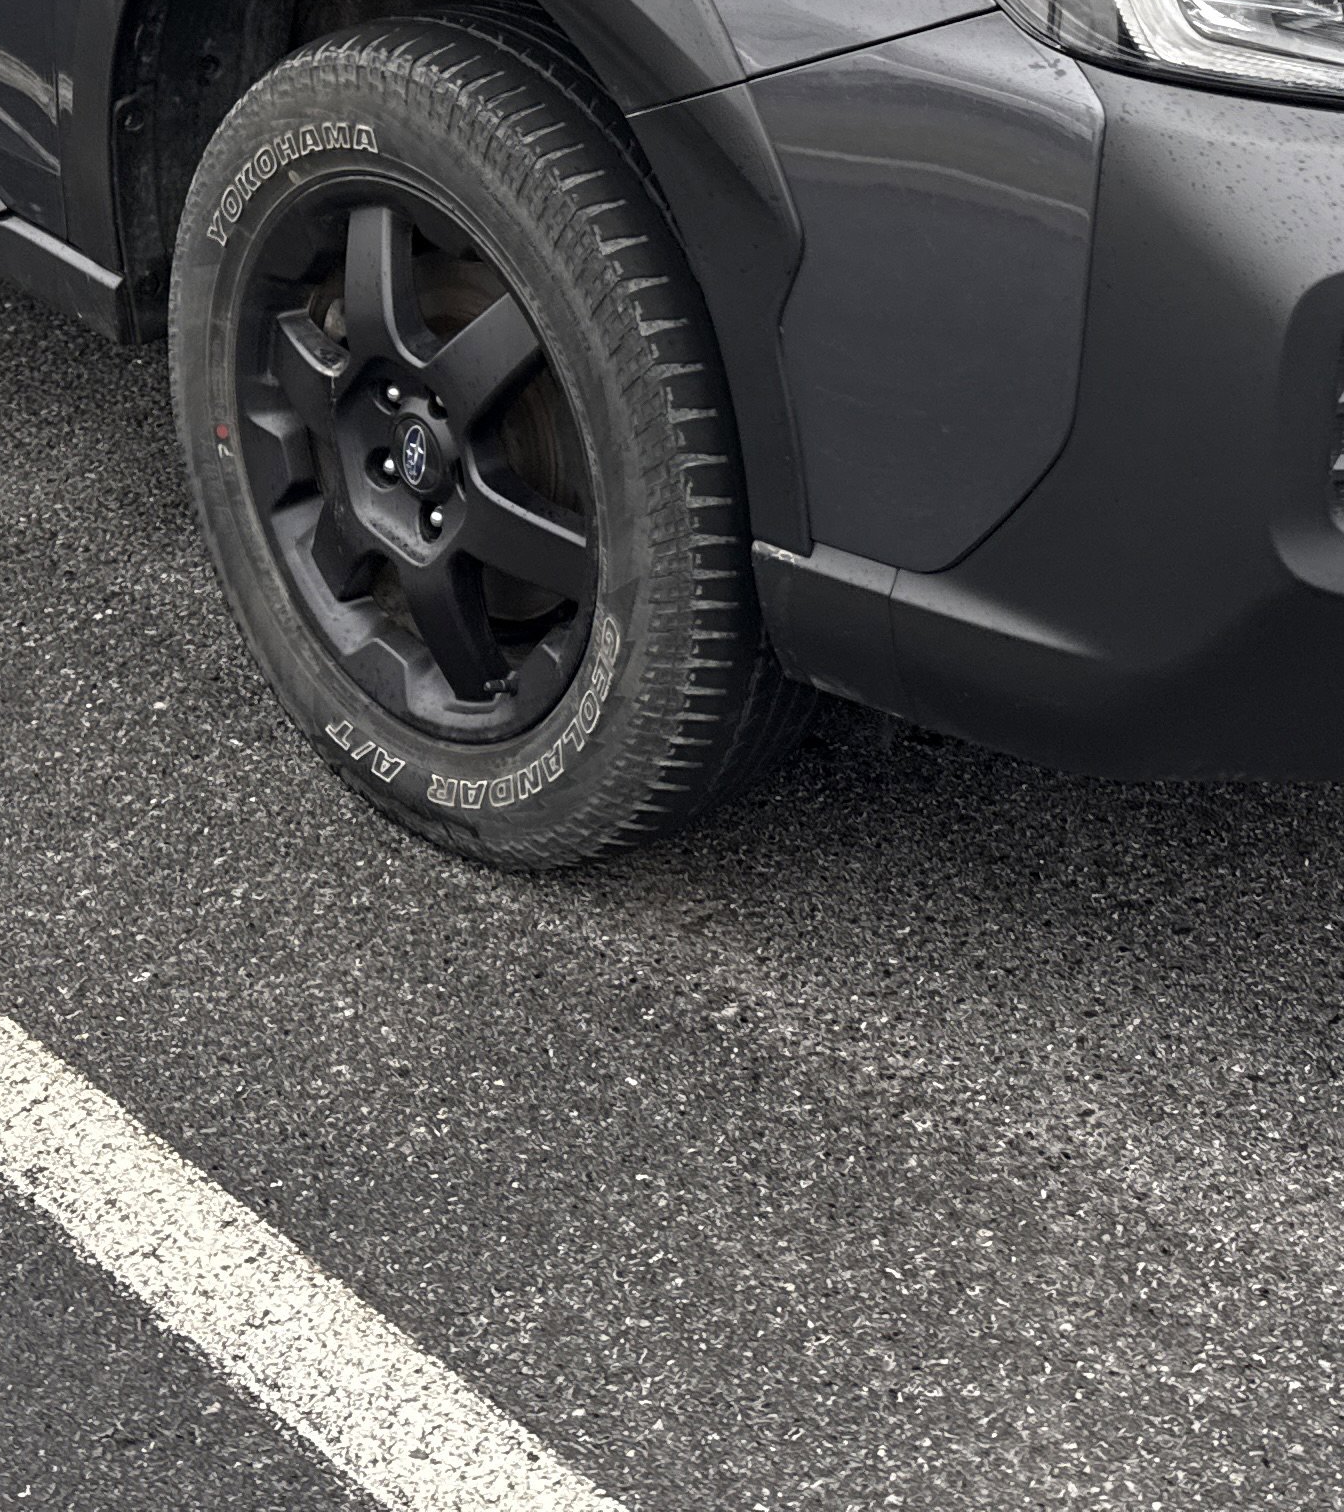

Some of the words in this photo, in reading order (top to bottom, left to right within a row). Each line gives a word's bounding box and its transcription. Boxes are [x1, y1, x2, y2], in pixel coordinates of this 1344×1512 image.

[206, 121, 379, 248] YOKOHAMA
[324, 719, 406, 783] A/T
[426, 616, 621, 810] GEOLANDAR
